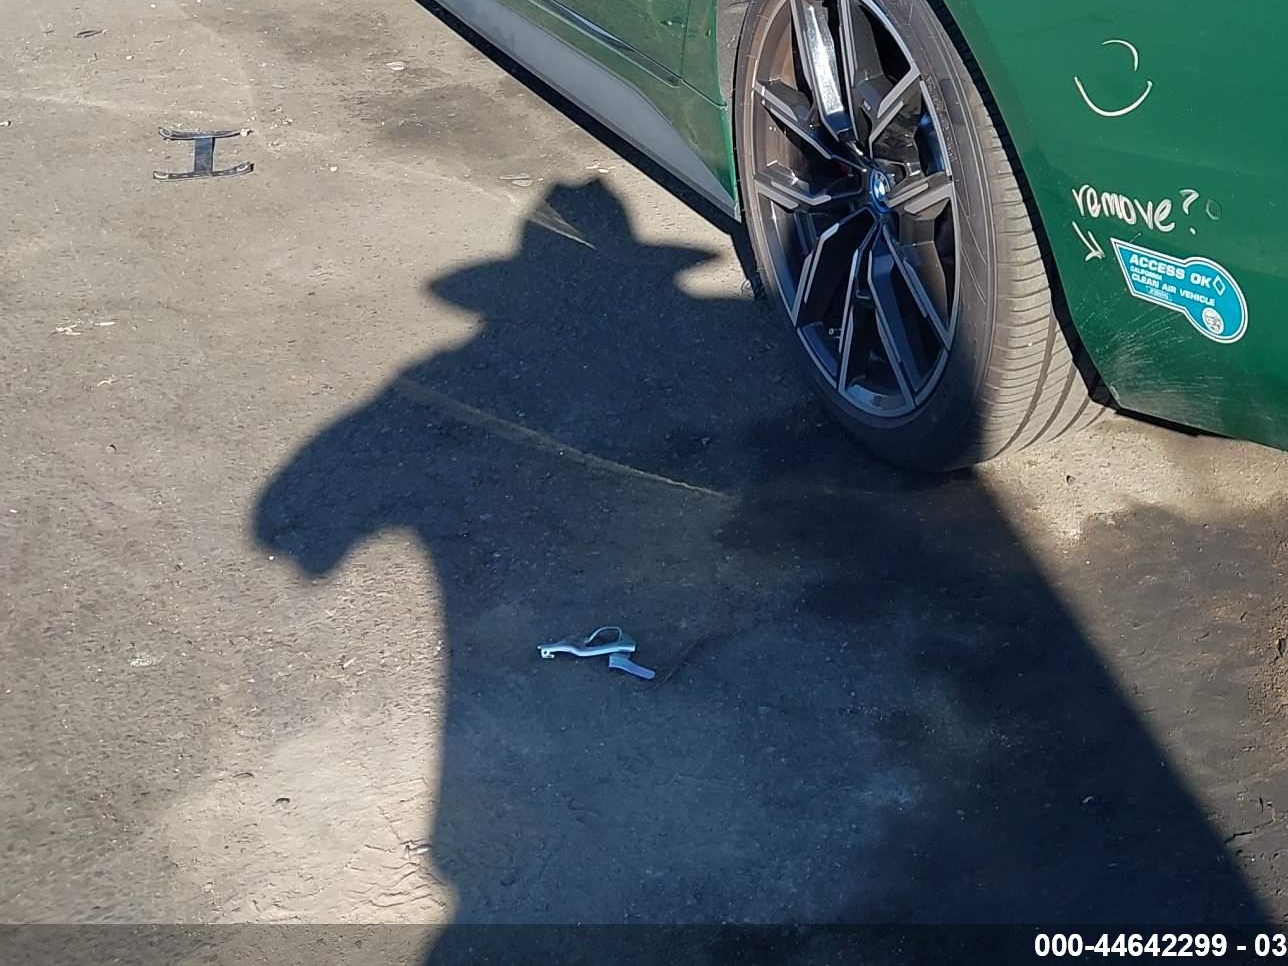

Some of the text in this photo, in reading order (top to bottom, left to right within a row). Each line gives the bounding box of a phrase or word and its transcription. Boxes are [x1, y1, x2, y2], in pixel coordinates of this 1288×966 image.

[1129, 254, 1213, 288] ACCESS OK
[1131, 273, 1160, 289] CLEAN
[1161, 283, 1177, 294] AIR
[1180, 288, 1216, 307] VEHICLE
